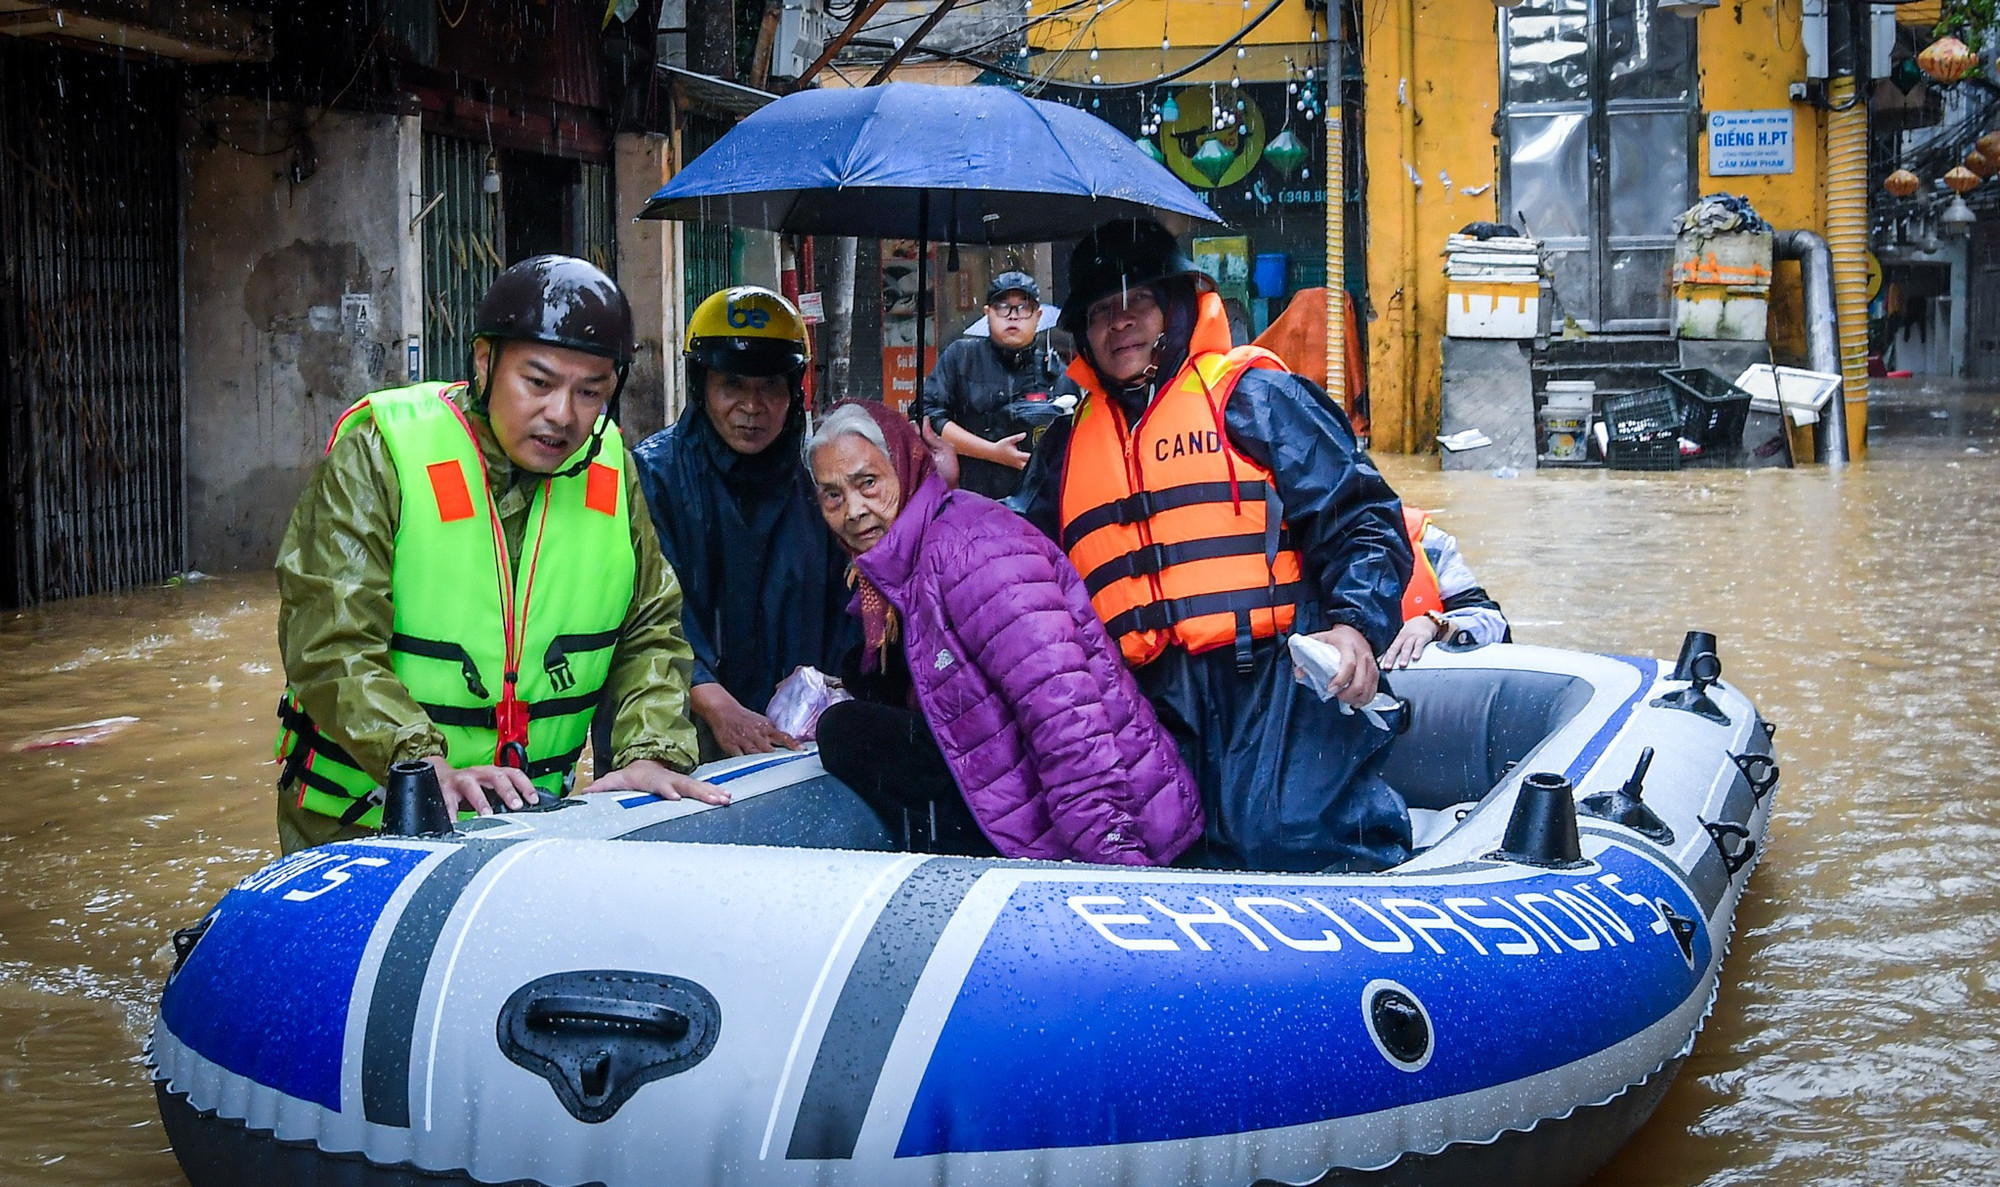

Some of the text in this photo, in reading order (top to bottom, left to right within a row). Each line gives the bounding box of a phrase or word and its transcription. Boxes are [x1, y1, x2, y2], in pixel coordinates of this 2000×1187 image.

[1714, 127, 1788, 147] GIẾNG H.PT
[727, 301, 770, 329] be
[1155, 430, 1222, 461] CAND
[1066, 872, 1669, 956] EXCURSION 5
